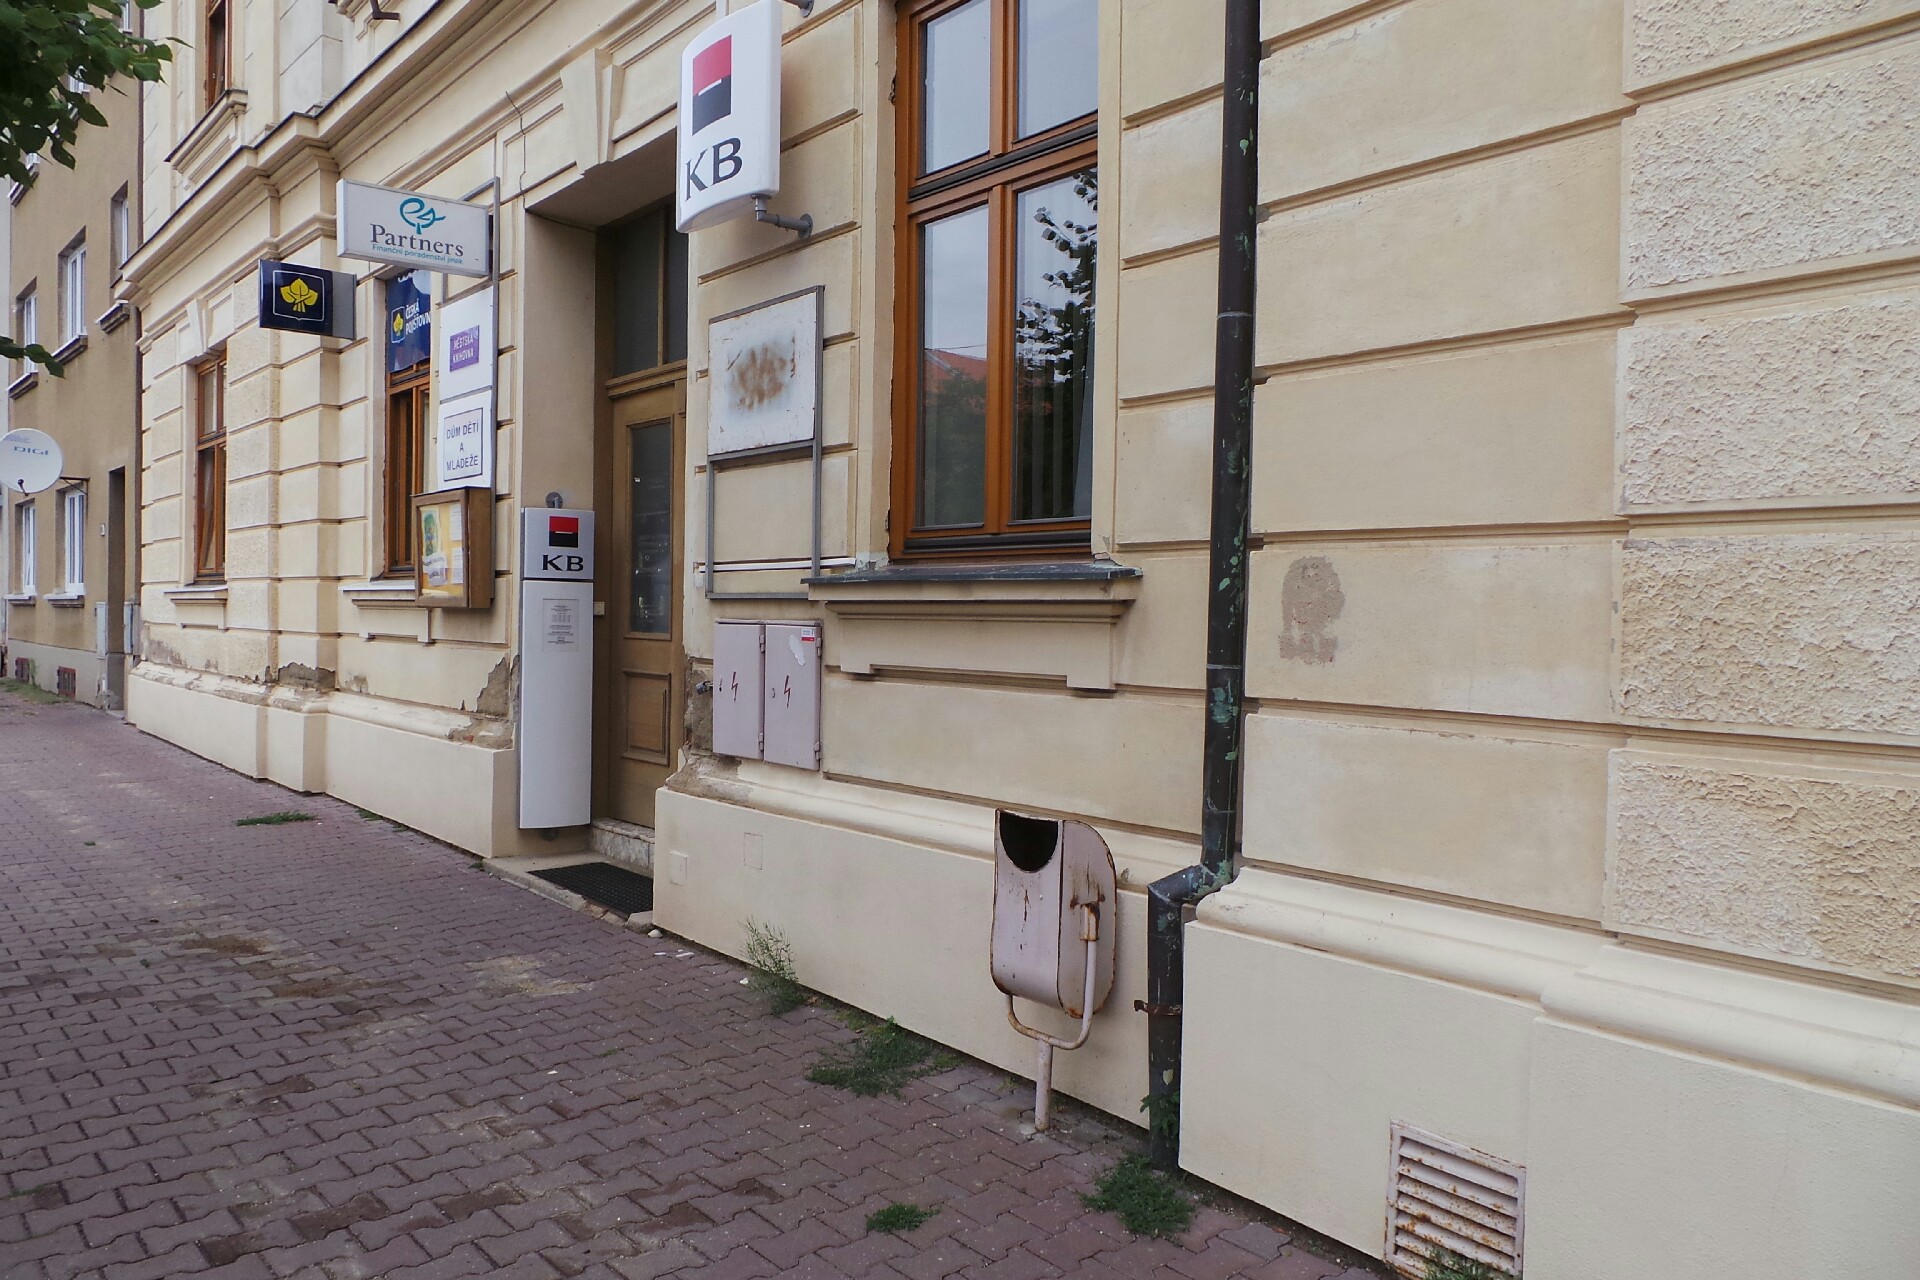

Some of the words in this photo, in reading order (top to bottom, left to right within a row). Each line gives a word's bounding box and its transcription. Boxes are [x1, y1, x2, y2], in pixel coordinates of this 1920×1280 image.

[685, 137, 743, 202] KB
[370, 223, 464, 257] Partners
[462, 420, 479, 436] DĚTÍ
[459, 442, 465, 452] A
[446, 453, 479, 471] MLÁDEŽE
[541, 554, 584, 572] KB
